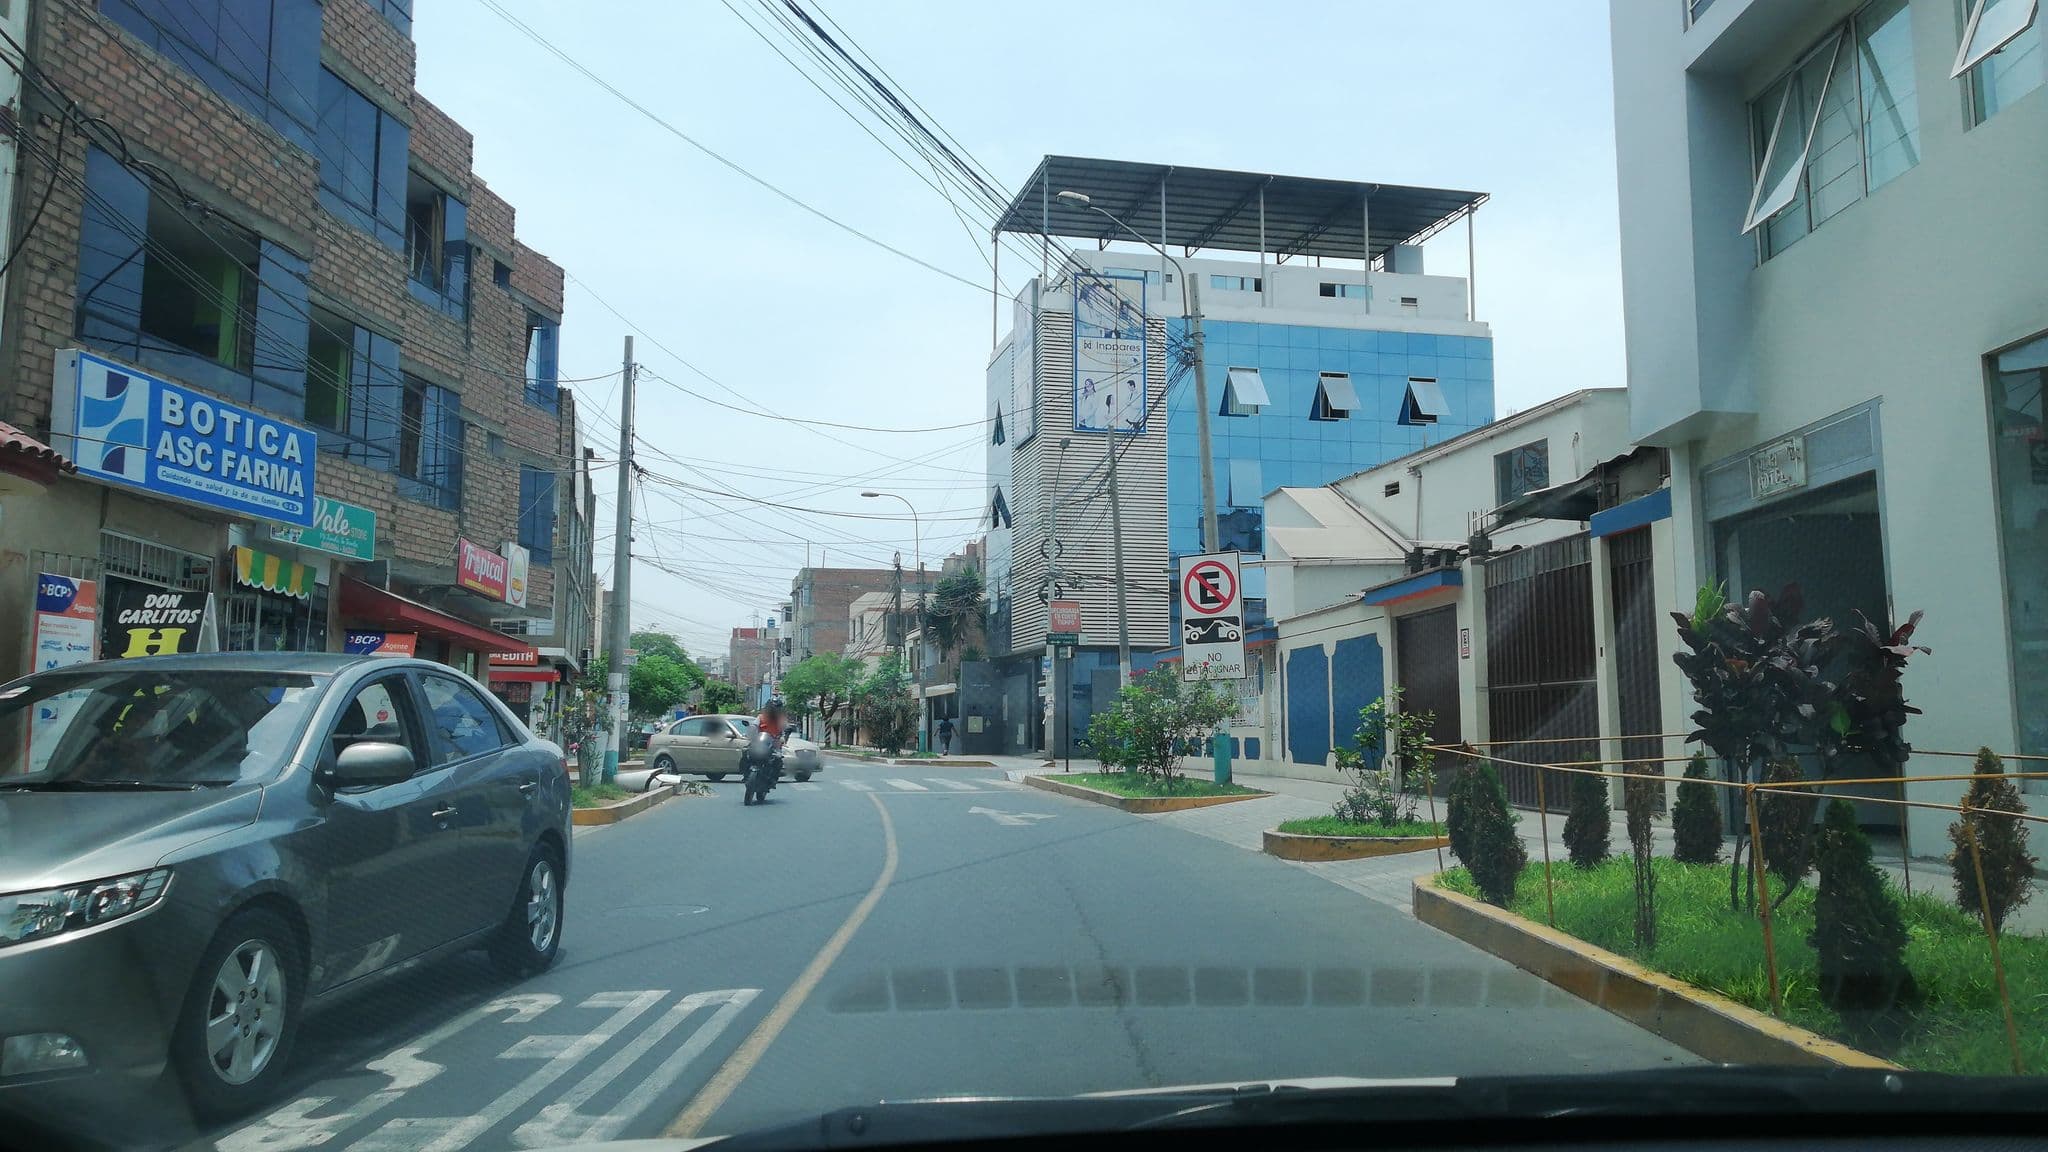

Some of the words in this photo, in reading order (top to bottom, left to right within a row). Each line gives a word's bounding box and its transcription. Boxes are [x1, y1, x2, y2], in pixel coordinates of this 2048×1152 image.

[161, 389, 303, 464] BOTICA
[155, 431, 213, 473] ASC
[221, 449, 304, 498] FARMA
[161, 470, 191, 485] Cuidando
[206, 482, 223, 493] salud
[313, 497, 350, 536] Vale
[464, 544, 504, 583] Tropical
[46, 584, 67, 597] BCP
[73, 603, 95, 613] Agente
[144, 594, 182, 608] DON
[118, 609, 201, 624] CARLITOS
[121, 628, 186, 659] H
[354, 635, 376, 644] BCP
[502, 652, 533, 661] EDITH
[1208, 653, 1222, 662] NO
